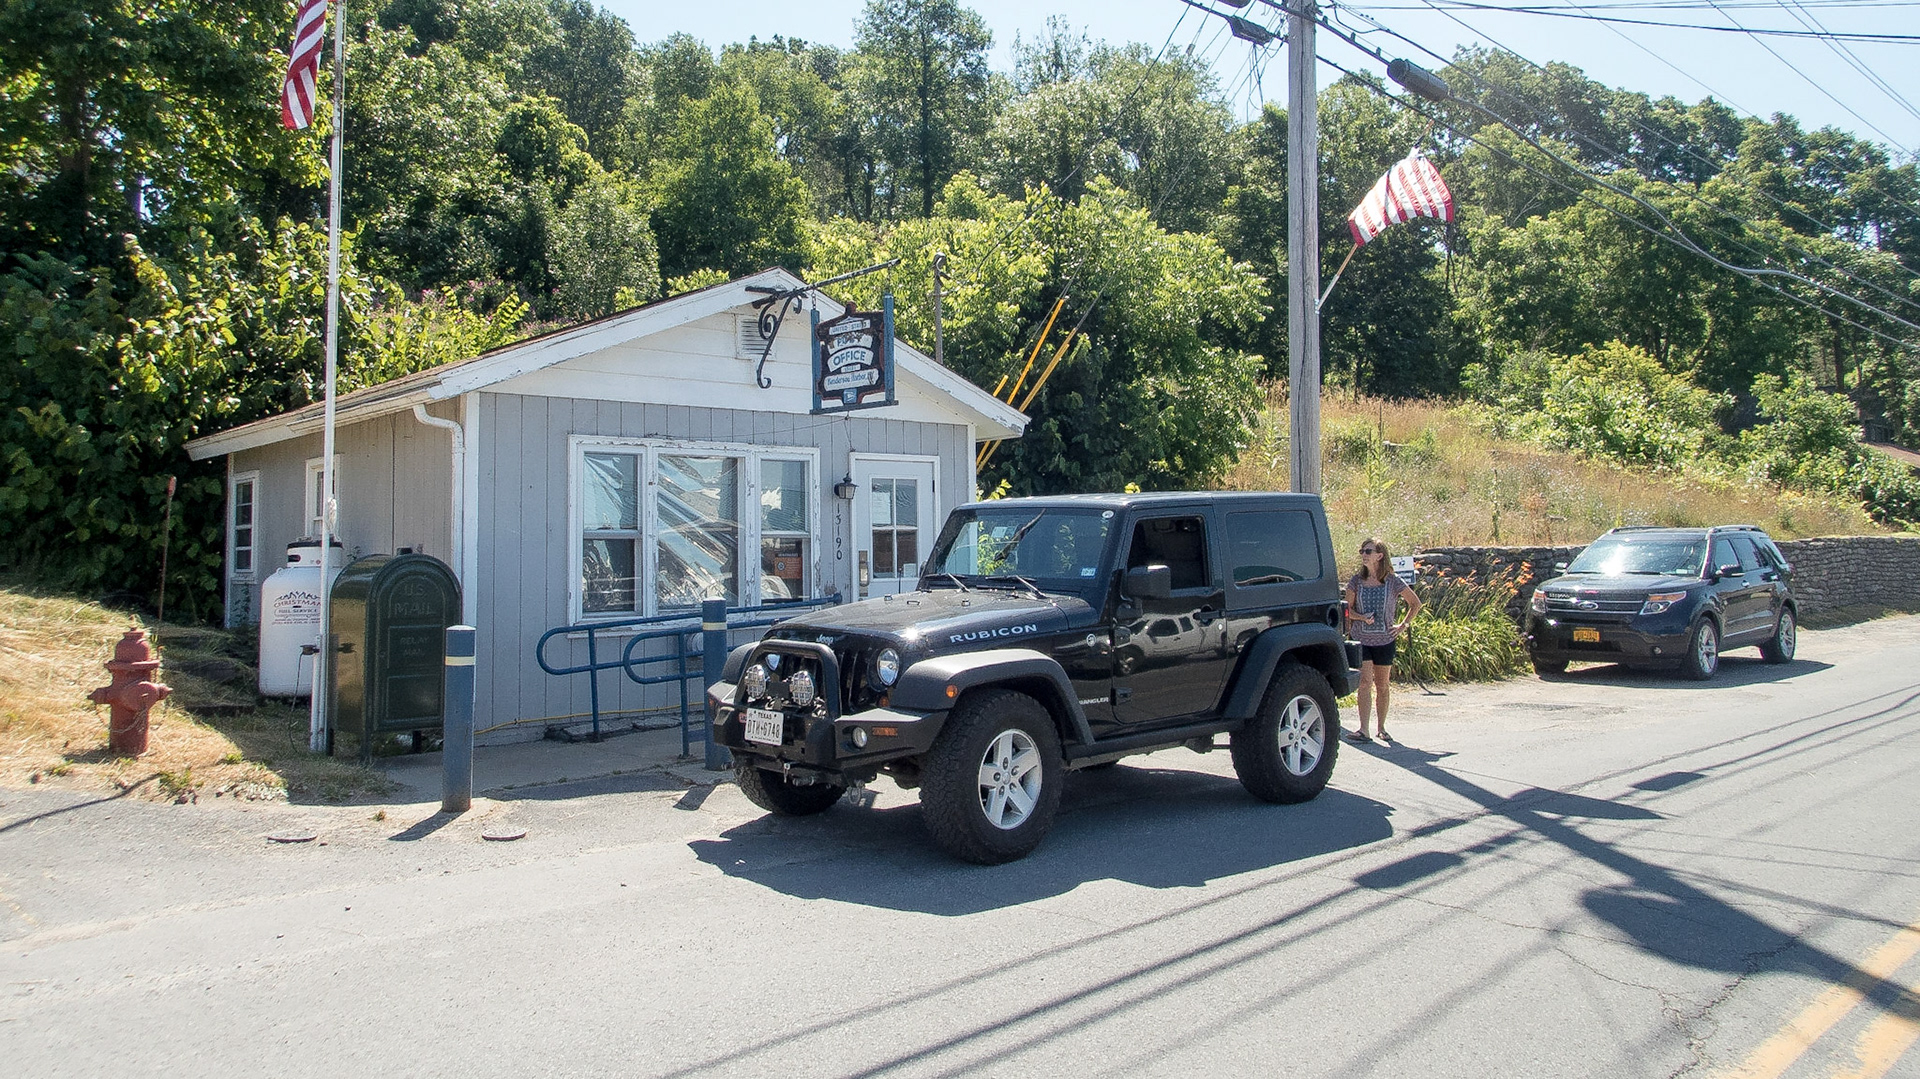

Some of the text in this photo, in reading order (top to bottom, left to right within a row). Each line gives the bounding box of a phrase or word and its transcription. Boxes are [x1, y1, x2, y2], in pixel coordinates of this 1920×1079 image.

[833, 350, 866, 366] OFFICE
[394, 602, 437, 616] MAIL
[815, 633, 834, 646] Jeep
[949, 624, 1037, 643] RUBICON
